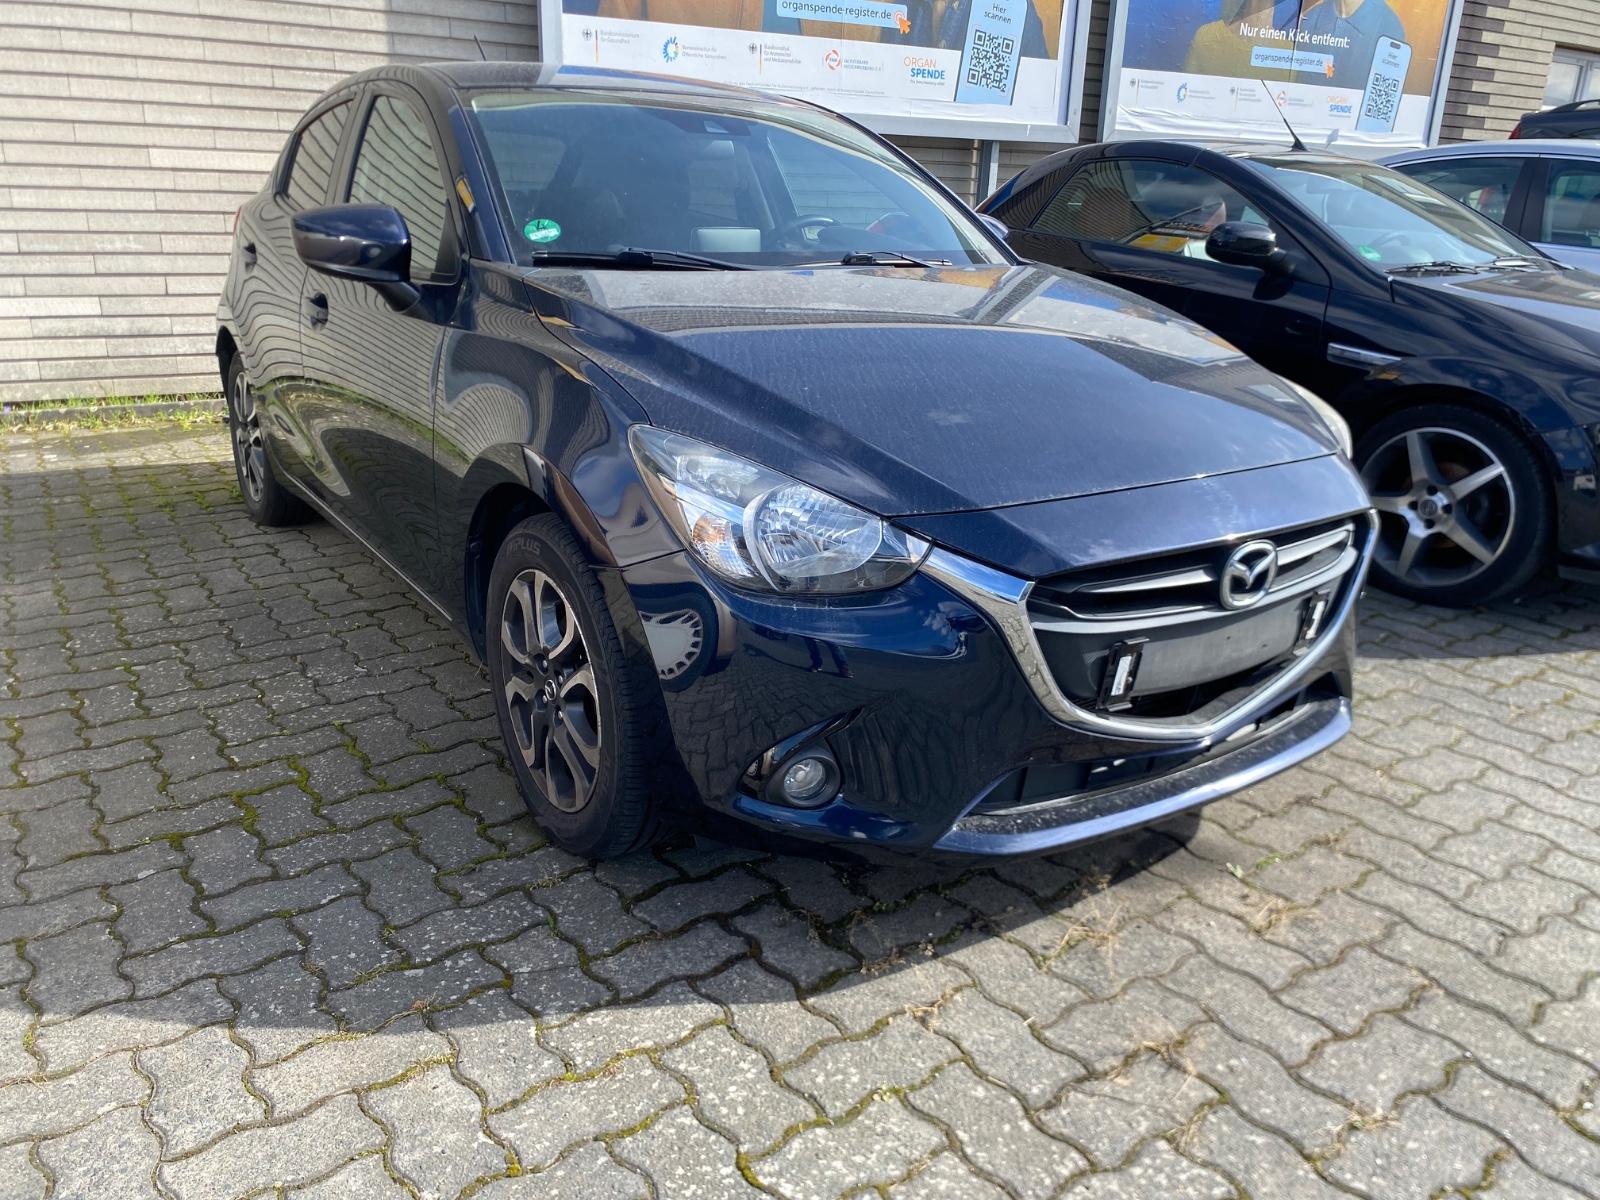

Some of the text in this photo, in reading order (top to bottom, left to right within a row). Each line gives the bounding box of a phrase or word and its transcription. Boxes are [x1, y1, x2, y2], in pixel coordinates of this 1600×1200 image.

[782, 1, 892, 19] organspende-register.de
[992, 3, 1007, 14] Hier
[983, 9, 1012, 24] scannen
[1240, 22, 1351, 48] Nur einen Kick entfernt:
[903, 56, 937, 69] ORGAN
[910, 68, 946, 80] SPENDE
